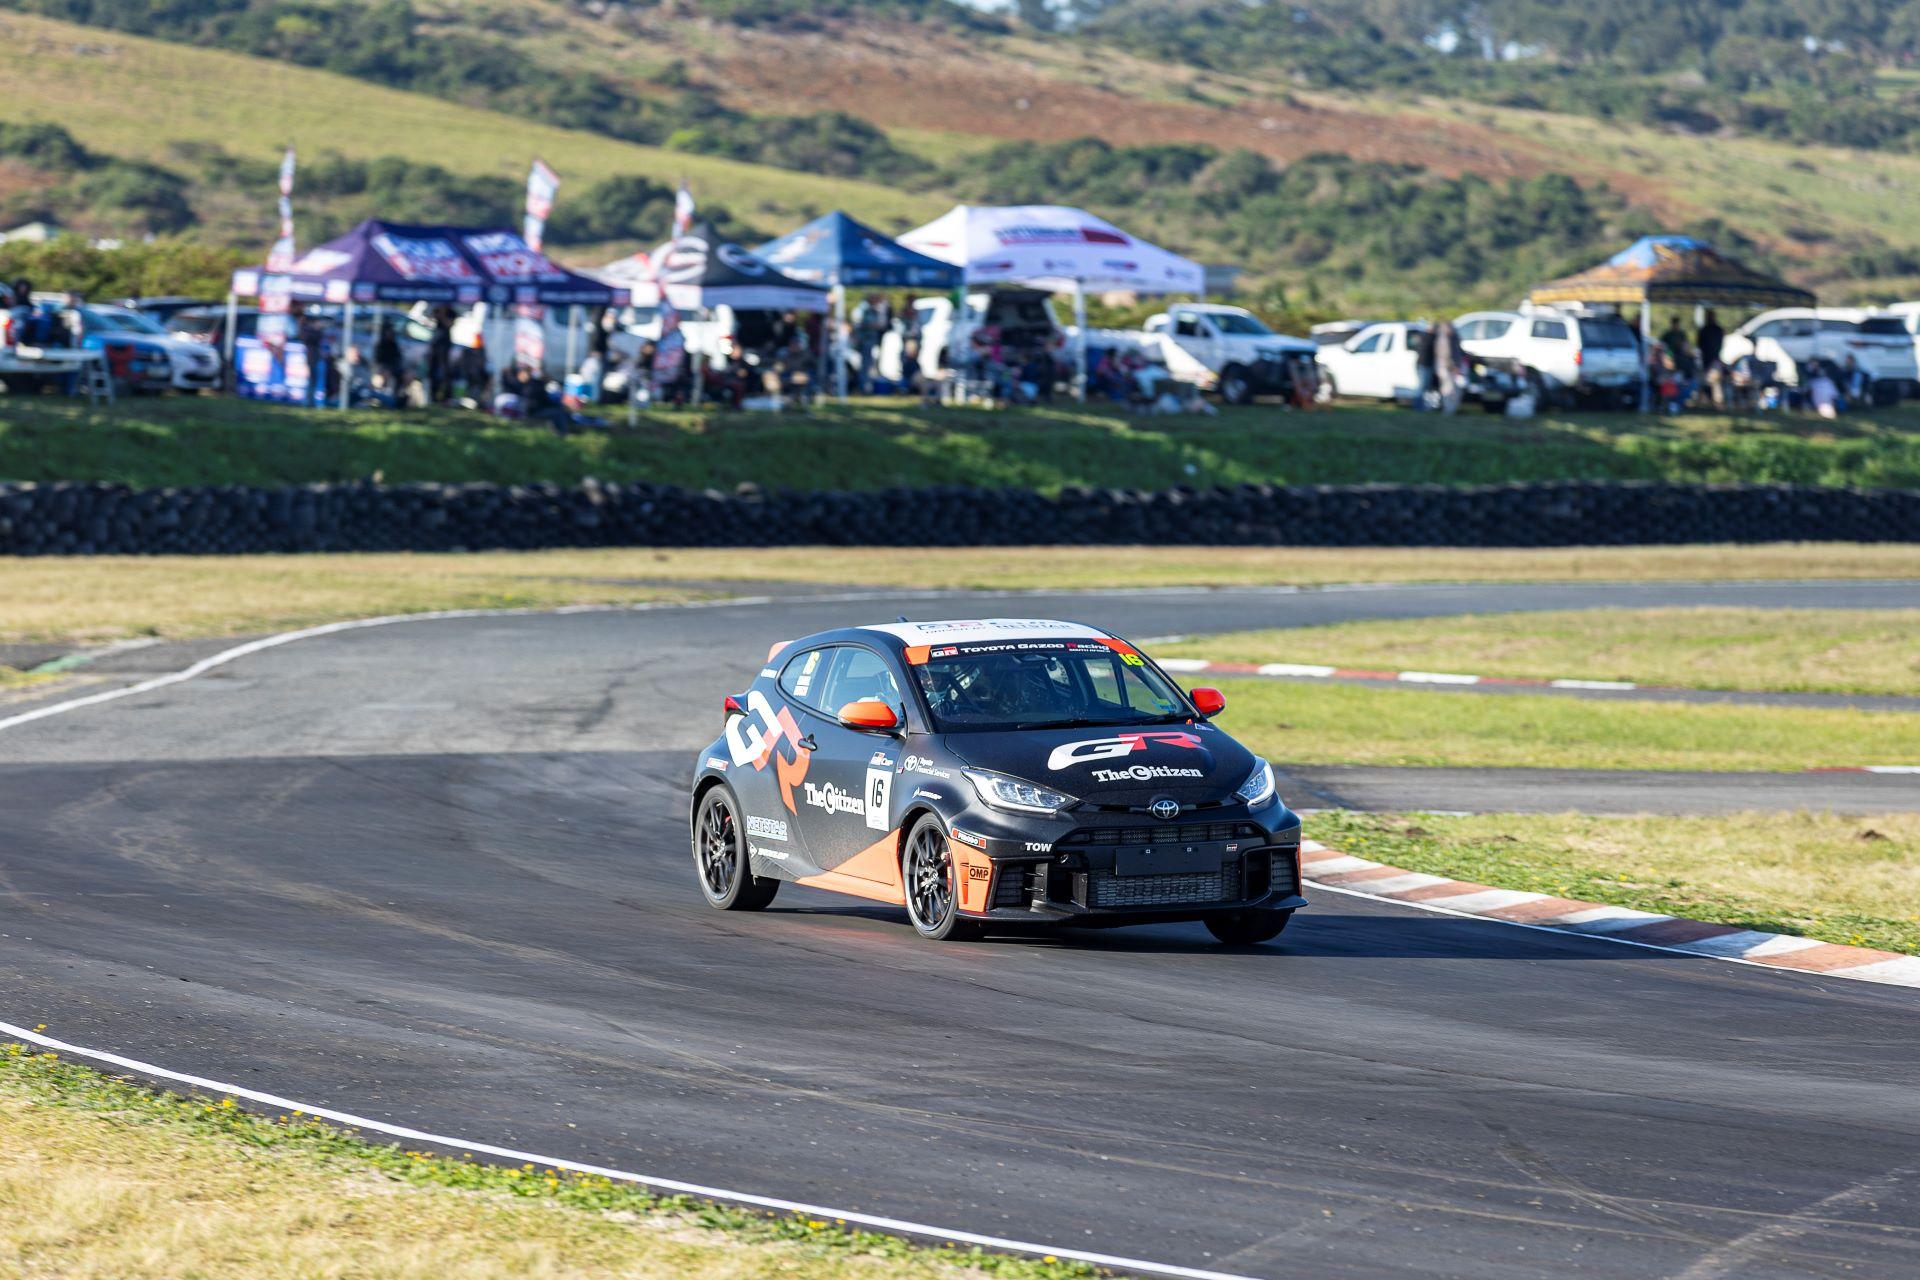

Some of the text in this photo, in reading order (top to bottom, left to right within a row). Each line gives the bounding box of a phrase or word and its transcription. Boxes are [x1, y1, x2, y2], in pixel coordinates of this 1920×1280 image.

[960, 645, 1015, 653] TOYOTA
[1066, 642, 1110, 651] Racing
[1118, 653, 1145, 667] 16
[1048, 732, 1202, 771] GR
[871, 778, 884, 808] 16
[1025, 842, 1053, 852] TOW
[969, 868, 989, 879] OMP
